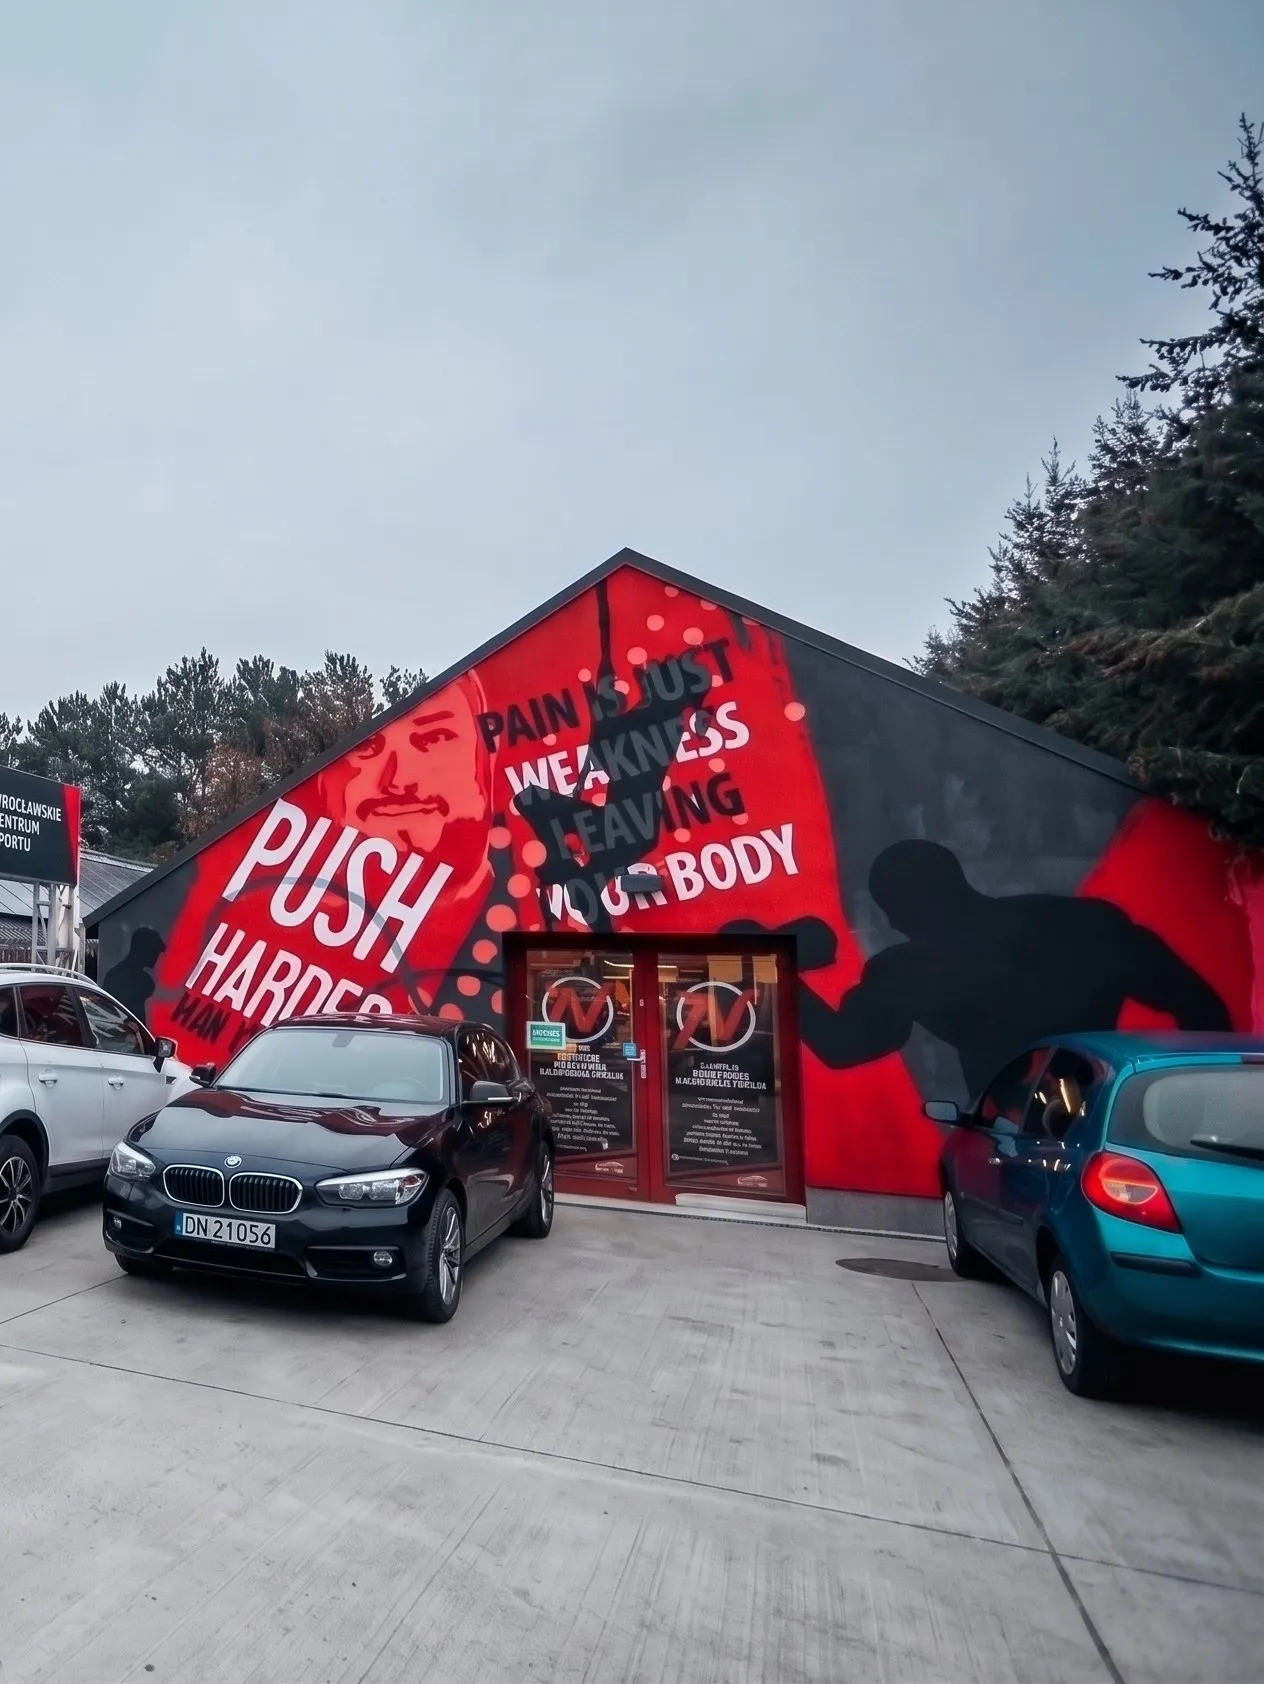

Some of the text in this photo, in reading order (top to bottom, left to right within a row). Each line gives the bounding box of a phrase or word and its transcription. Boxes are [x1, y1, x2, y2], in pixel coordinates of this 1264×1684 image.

[476, 638, 734, 753] PAIN IS JUST
[504, 702, 750, 806] WEAKNESS
[551, 772, 748, 860] LEAVING
[664, 823, 798, 901] BODY
[222, 798, 454, 973] PUSH
[185, 1216, 271, 1245] DN 21056
